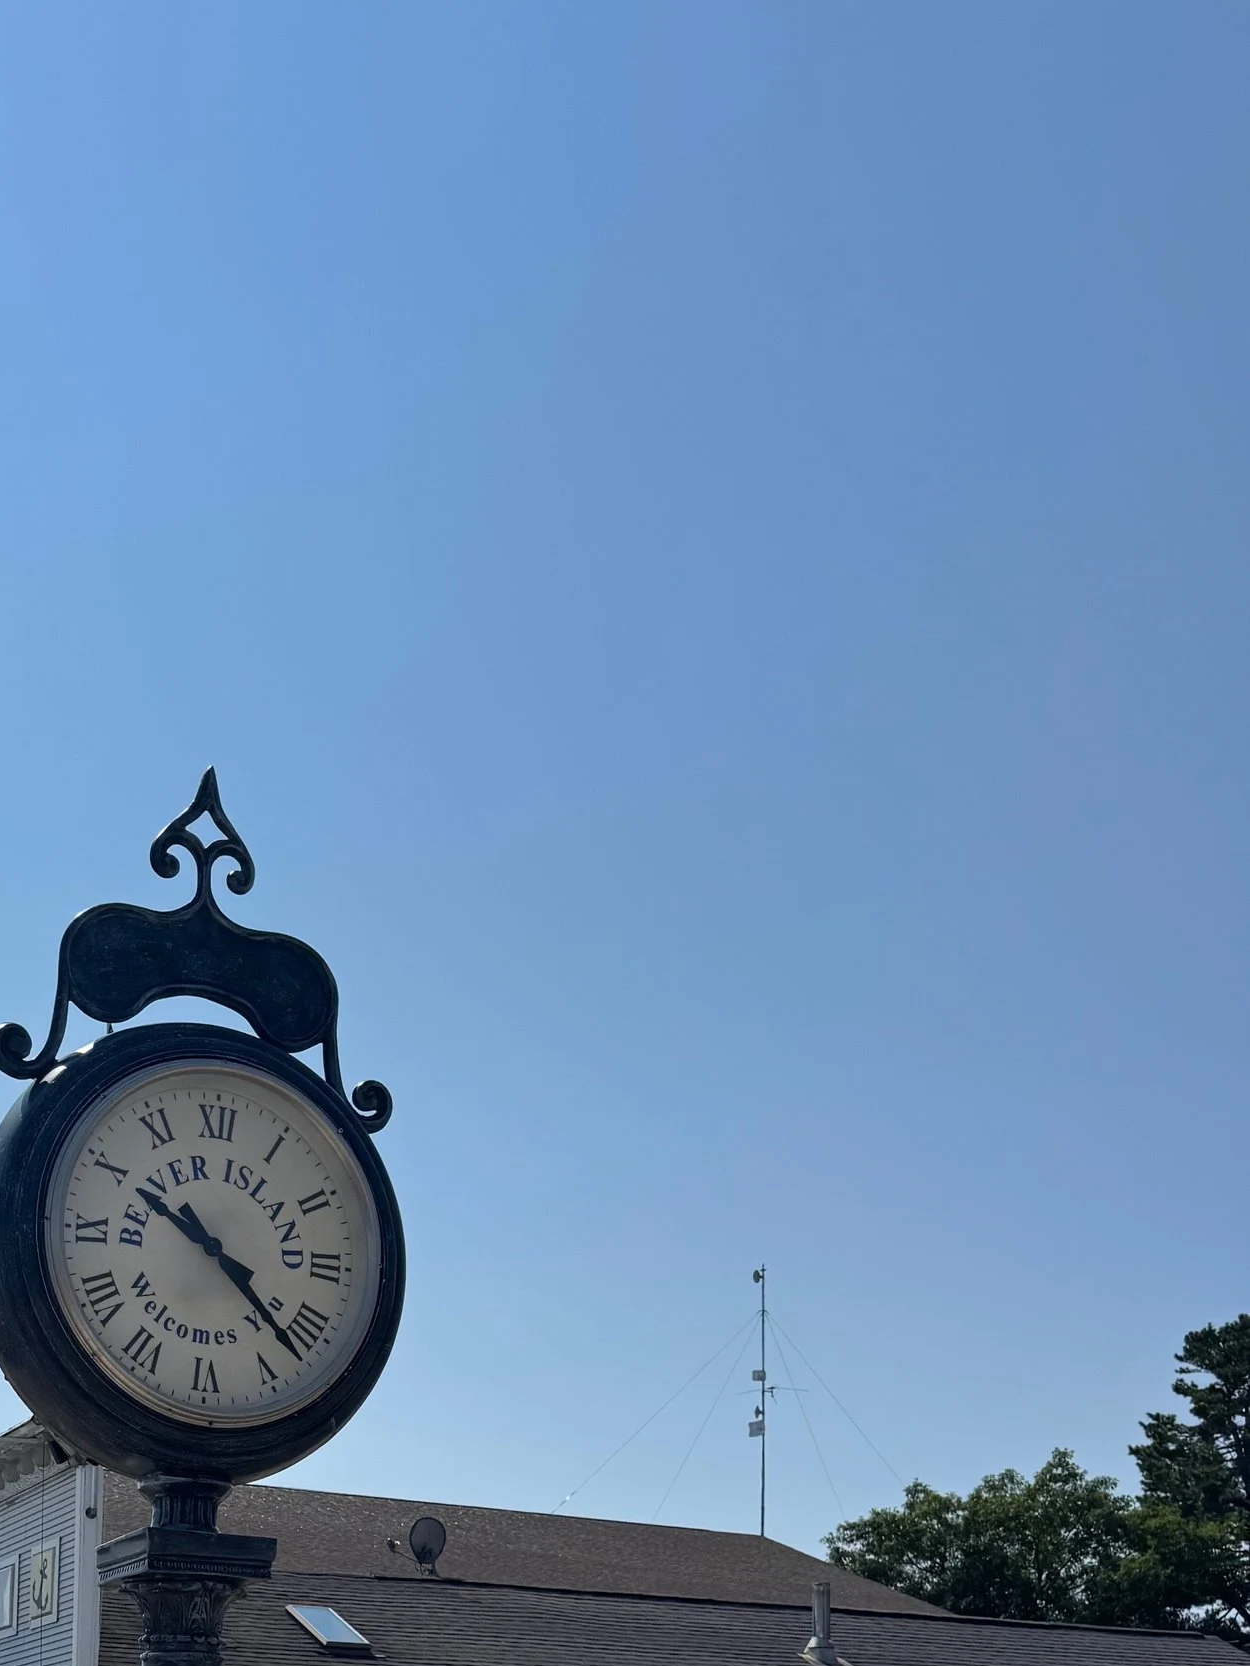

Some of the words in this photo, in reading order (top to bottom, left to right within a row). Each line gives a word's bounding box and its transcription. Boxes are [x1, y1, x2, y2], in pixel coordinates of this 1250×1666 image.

[138, 1107, 177, 1150] XI
[198, 1103, 238, 1143] XII
[263, 1133, 286, 1165] I
[93, 1151, 130, 1187] X
[222, 1158, 304, 1270] ISLAND
[297, 1188, 331, 1216] II
[75, 1212, 109, 1246] IX
[310, 1251, 341, 1286] III
[80, 1269, 125, 1328] VIII
[131, 1271, 238, 1346] Welcomes
[243, 1296, 285, 1333] Yu
[286, 1300, 330, 1351] IIII
[121, 1325, 162, 1376] VII
[257, 1351, 279, 1386] V
[191, 1357, 220, 1393] VI
